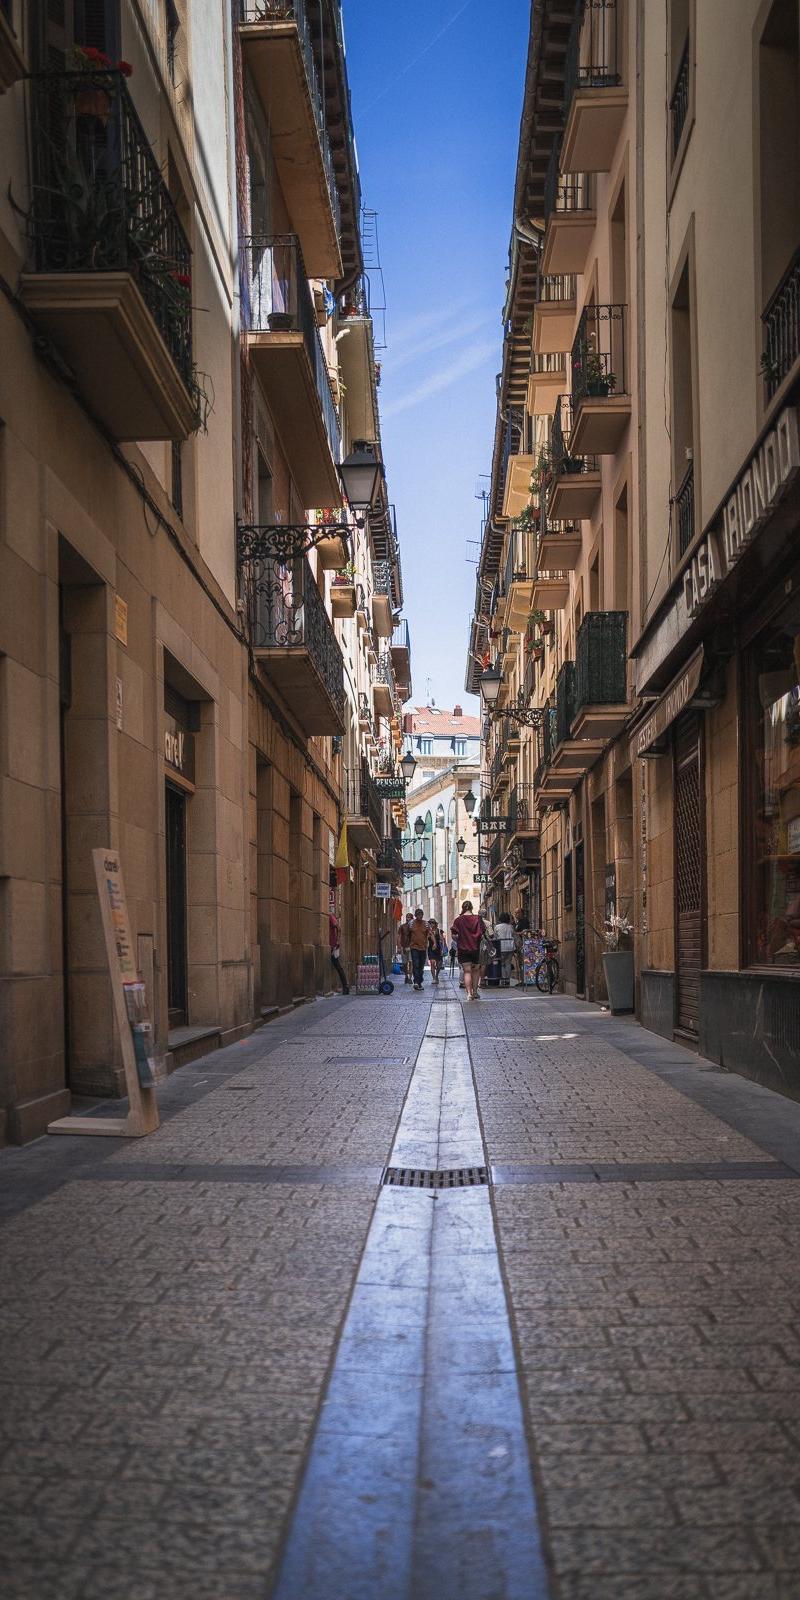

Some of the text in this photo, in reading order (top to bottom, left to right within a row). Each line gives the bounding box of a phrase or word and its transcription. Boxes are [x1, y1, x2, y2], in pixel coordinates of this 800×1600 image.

[683, 406, 799, 618] CASA IRIONDO
[481, 821, 507, 831] BAR
